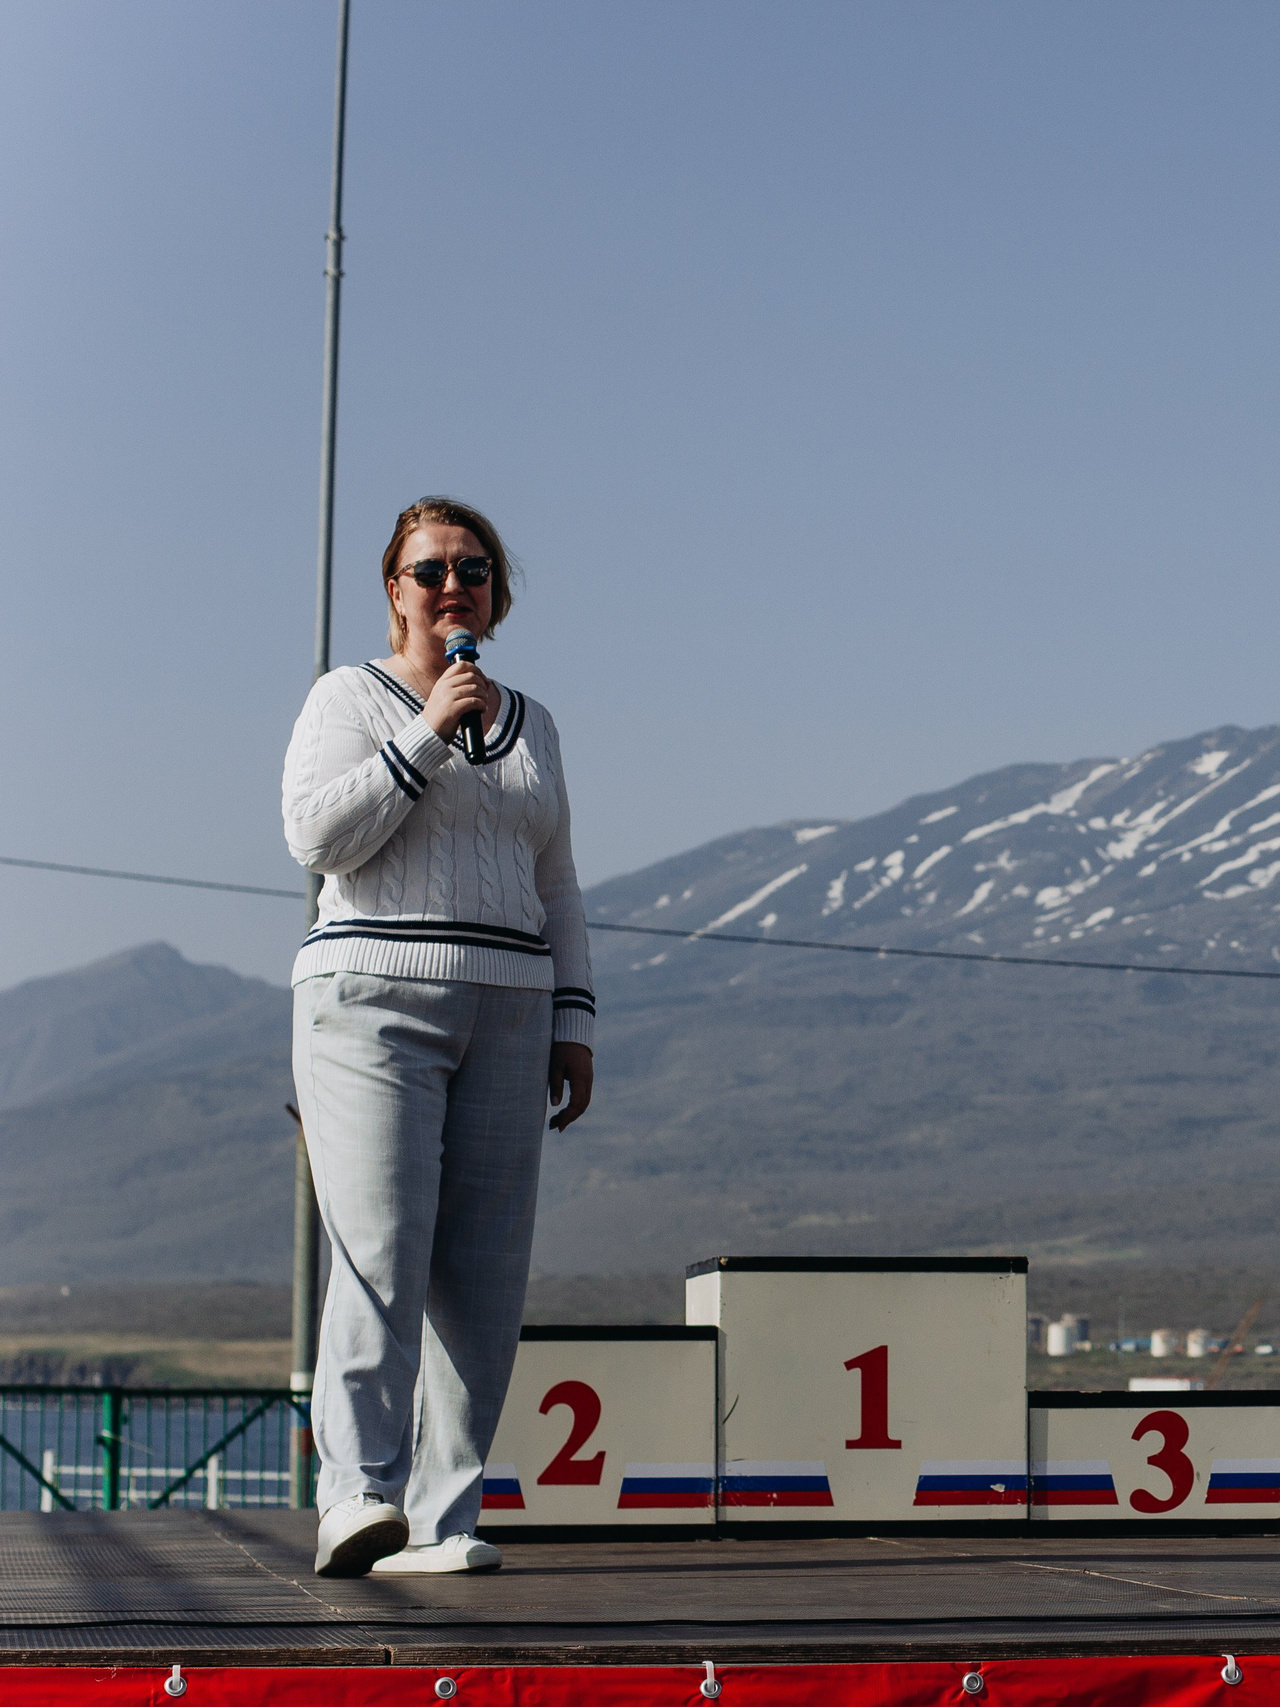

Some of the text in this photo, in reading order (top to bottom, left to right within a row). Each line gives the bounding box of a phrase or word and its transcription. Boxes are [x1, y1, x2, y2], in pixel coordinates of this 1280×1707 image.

[537, 1380, 606, 1485] 2
[844, 1345, 902, 1449] 1
[1129, 1410, 1194, 1513] 3
